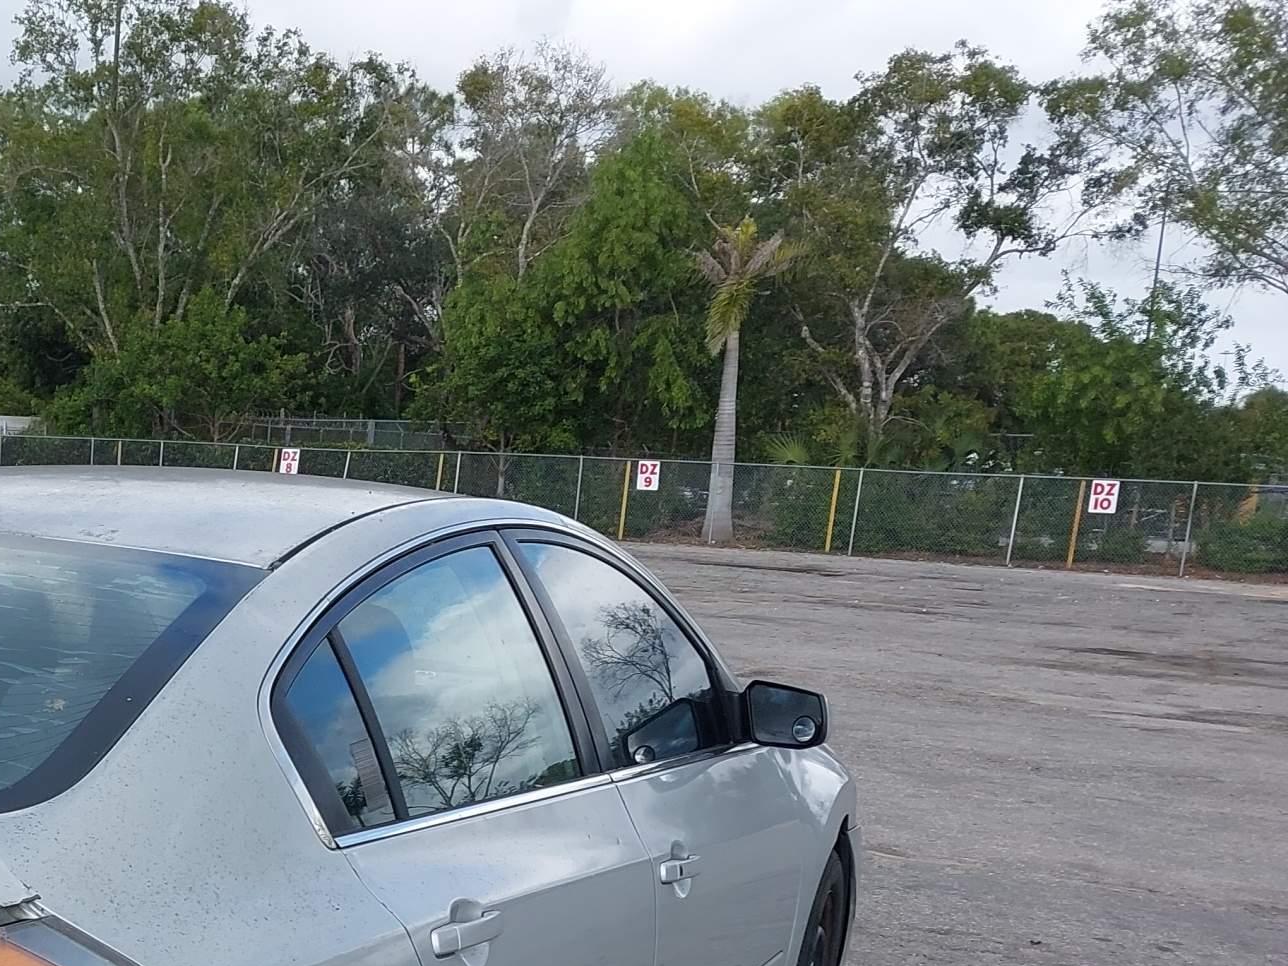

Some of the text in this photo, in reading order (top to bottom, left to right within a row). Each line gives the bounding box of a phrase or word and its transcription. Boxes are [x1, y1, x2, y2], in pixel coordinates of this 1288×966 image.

[283, 451, 298, 461] DZ
[285, 463, 292, 473] 8
[639, 463, 658, 475] DZ
[644, 476, 652, 487] 9
[1093, 483, 1117, 496] DZ
[1093, 497, 1111, 510] 10
